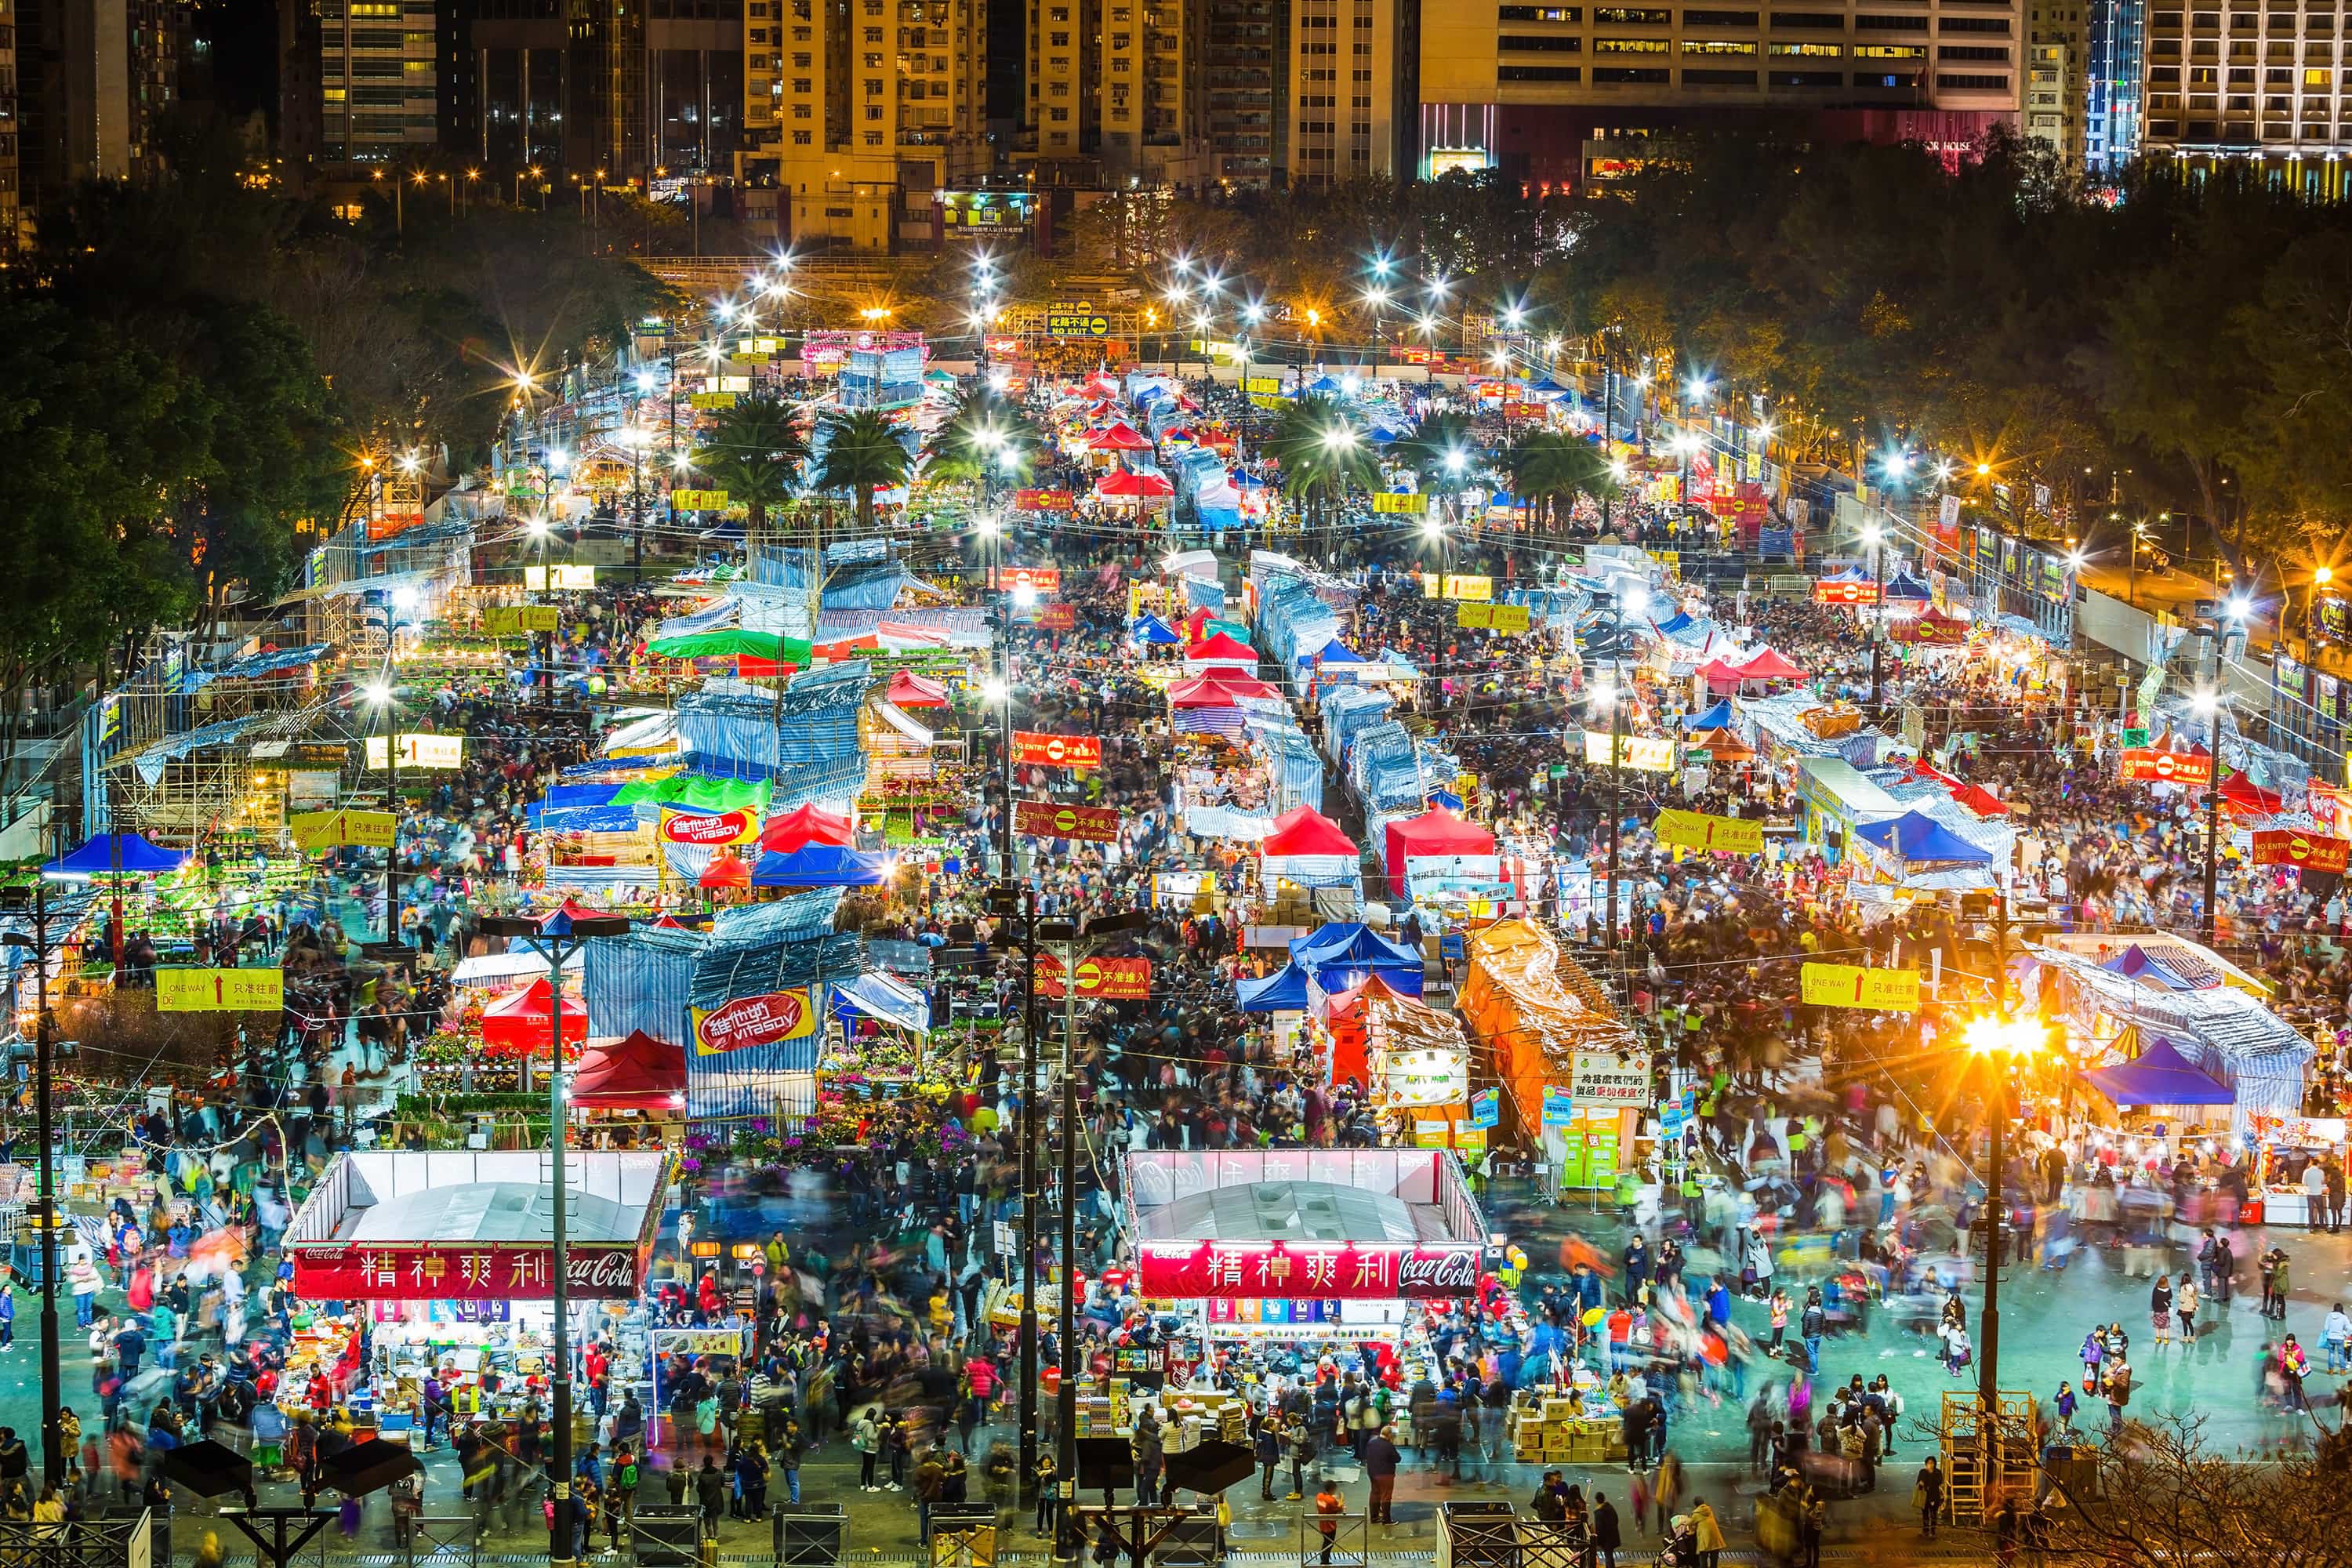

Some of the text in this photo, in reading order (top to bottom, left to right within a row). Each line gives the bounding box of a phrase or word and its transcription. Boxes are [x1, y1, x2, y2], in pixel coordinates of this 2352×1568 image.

[1944, 141, 1972, 151] HOUSE
[1051, 316, 1090, 327] 此路不通
[1025, 742, 1047, 751] ENTRY
[1065, 746, 1098, 757] 不准進入
[2175, 763, 2207, 775] 不准進入
[1030, 812, 1053, 821] ENTRY
[353, 822, 391, 834] 只准往前
[673, 817, 723, 833] 維他奶
[1078, 818, 1114, 829] 不准進入
[1668, 822, 1683, 830] ONE
[1722, 829, 1758, 841] 只准往前
[2310, 848, 2344, 860] 不准進入
[1046, 968, 1067, 978] ENTR
[1103, 971, 1146, 983] 不准進入
[1811, 978, 1828, 986] ONE
[169, 984, 187, 993] ONE
[234, 982, 278, 995] 只准往前
[1872, 982, 1915, 995] 只准往前
[162, 996, 174, 1005] D6
[709, 1002, 771, 1036] 維他奶
[306, 1247, 346, 1260] Coca-Cola
[1152, 1247, 1192, 1259] Coca-Cola
[360, 1250, 546, 1291] 精神爽利
[564, 1251, 633, 1287] ca-Cola
[1207, 1250, 1388, 1292] 精神爽利
[1399, 1251, 1475, 1288] Coca-Cola
